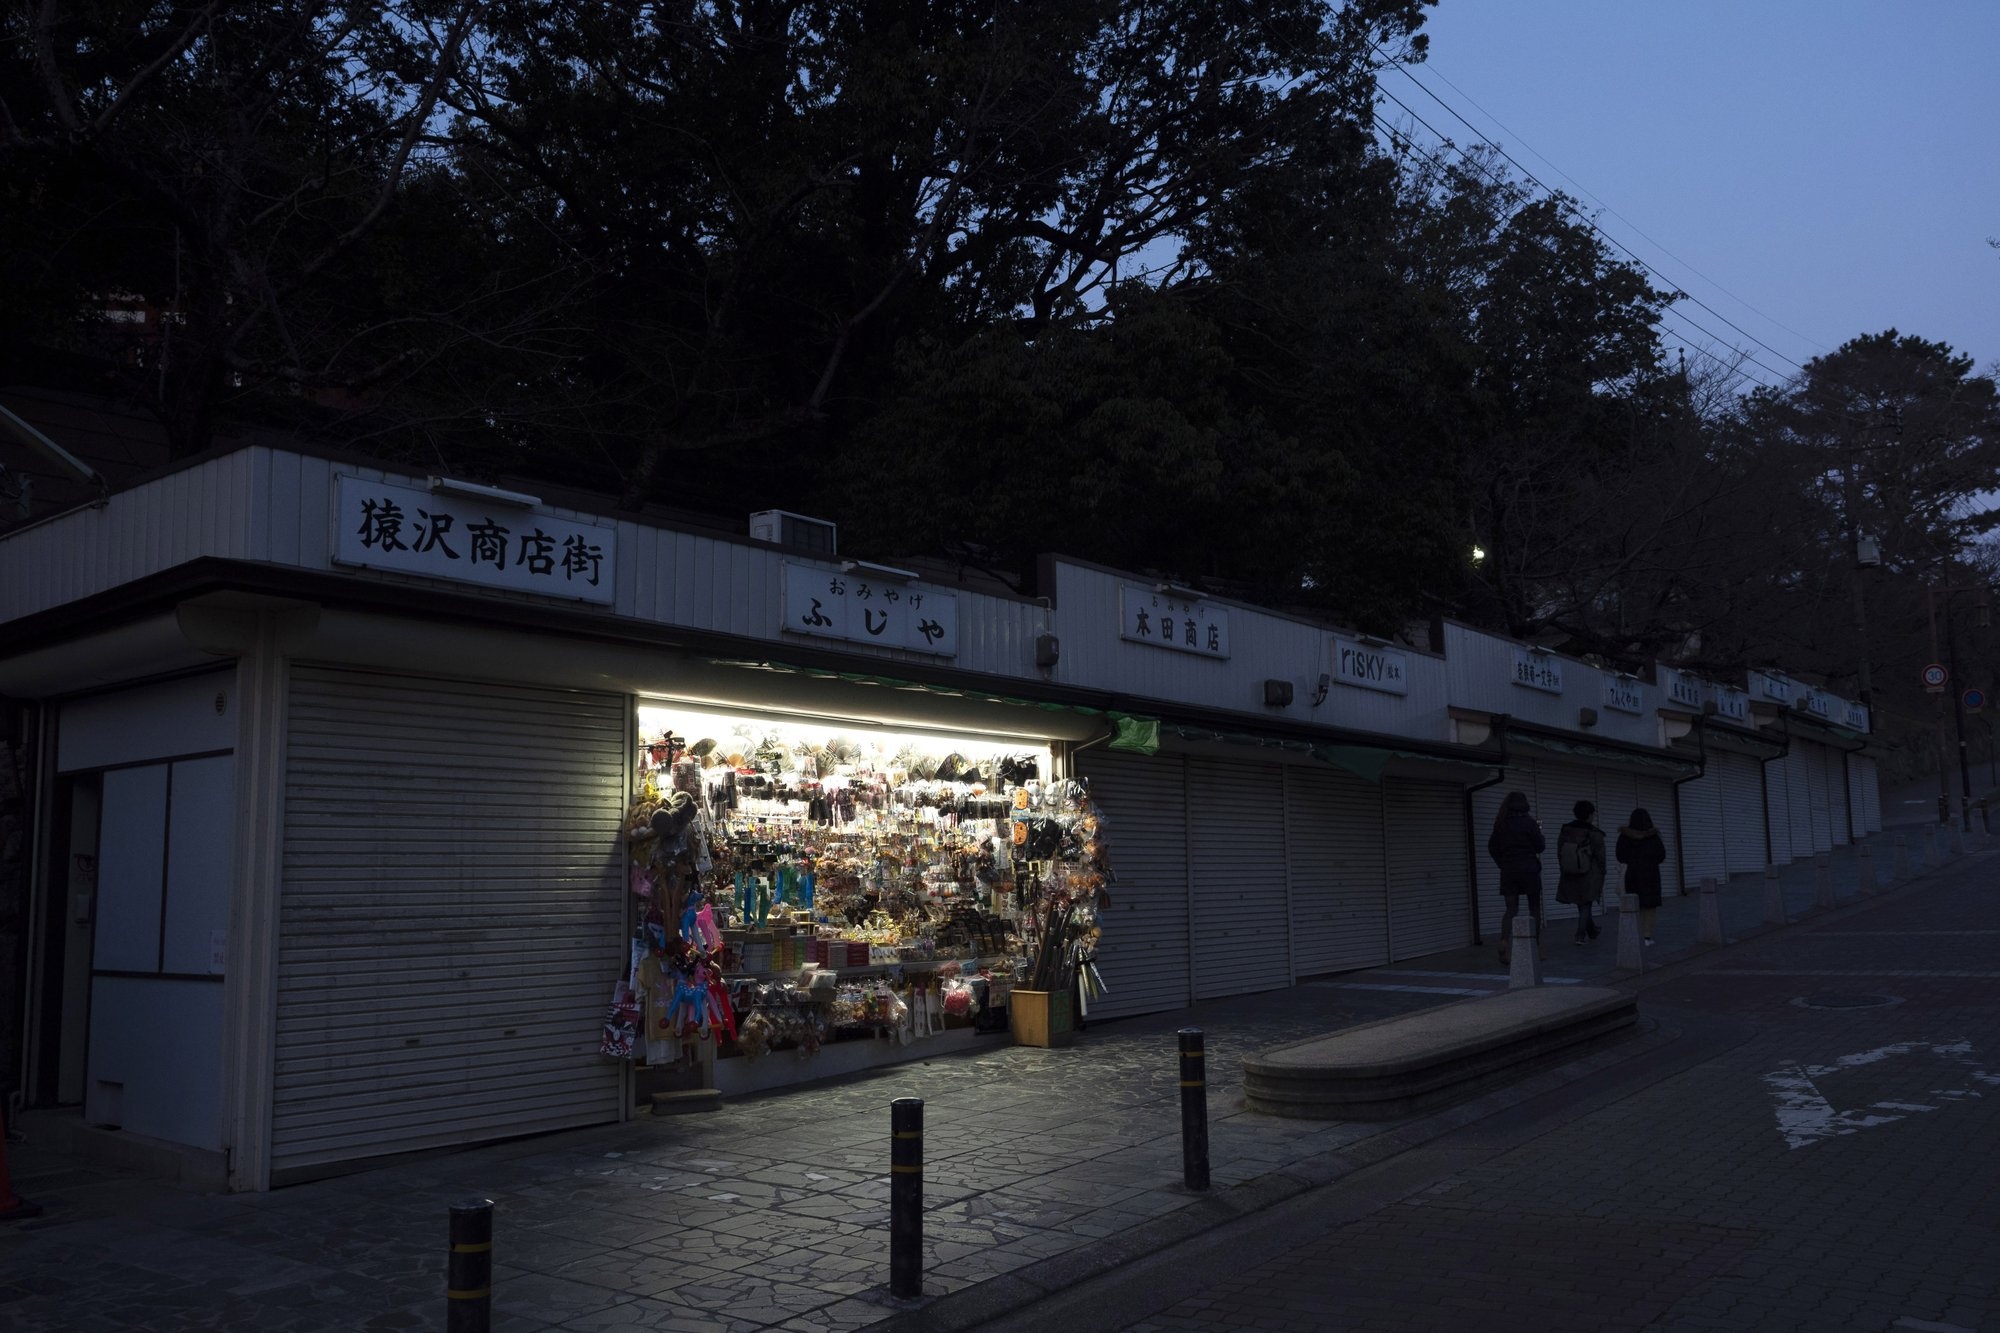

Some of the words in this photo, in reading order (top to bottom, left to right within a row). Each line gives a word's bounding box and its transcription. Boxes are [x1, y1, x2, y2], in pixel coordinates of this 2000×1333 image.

[357, 498, 603, 586] 猿沢商店街
[830, 577, 922, 610] おみやげ
[802, 597, 945, 645] ふじや
[1136, 607, 1218, 651] 本田商店
[1928, 671, 1941, 681] 30
